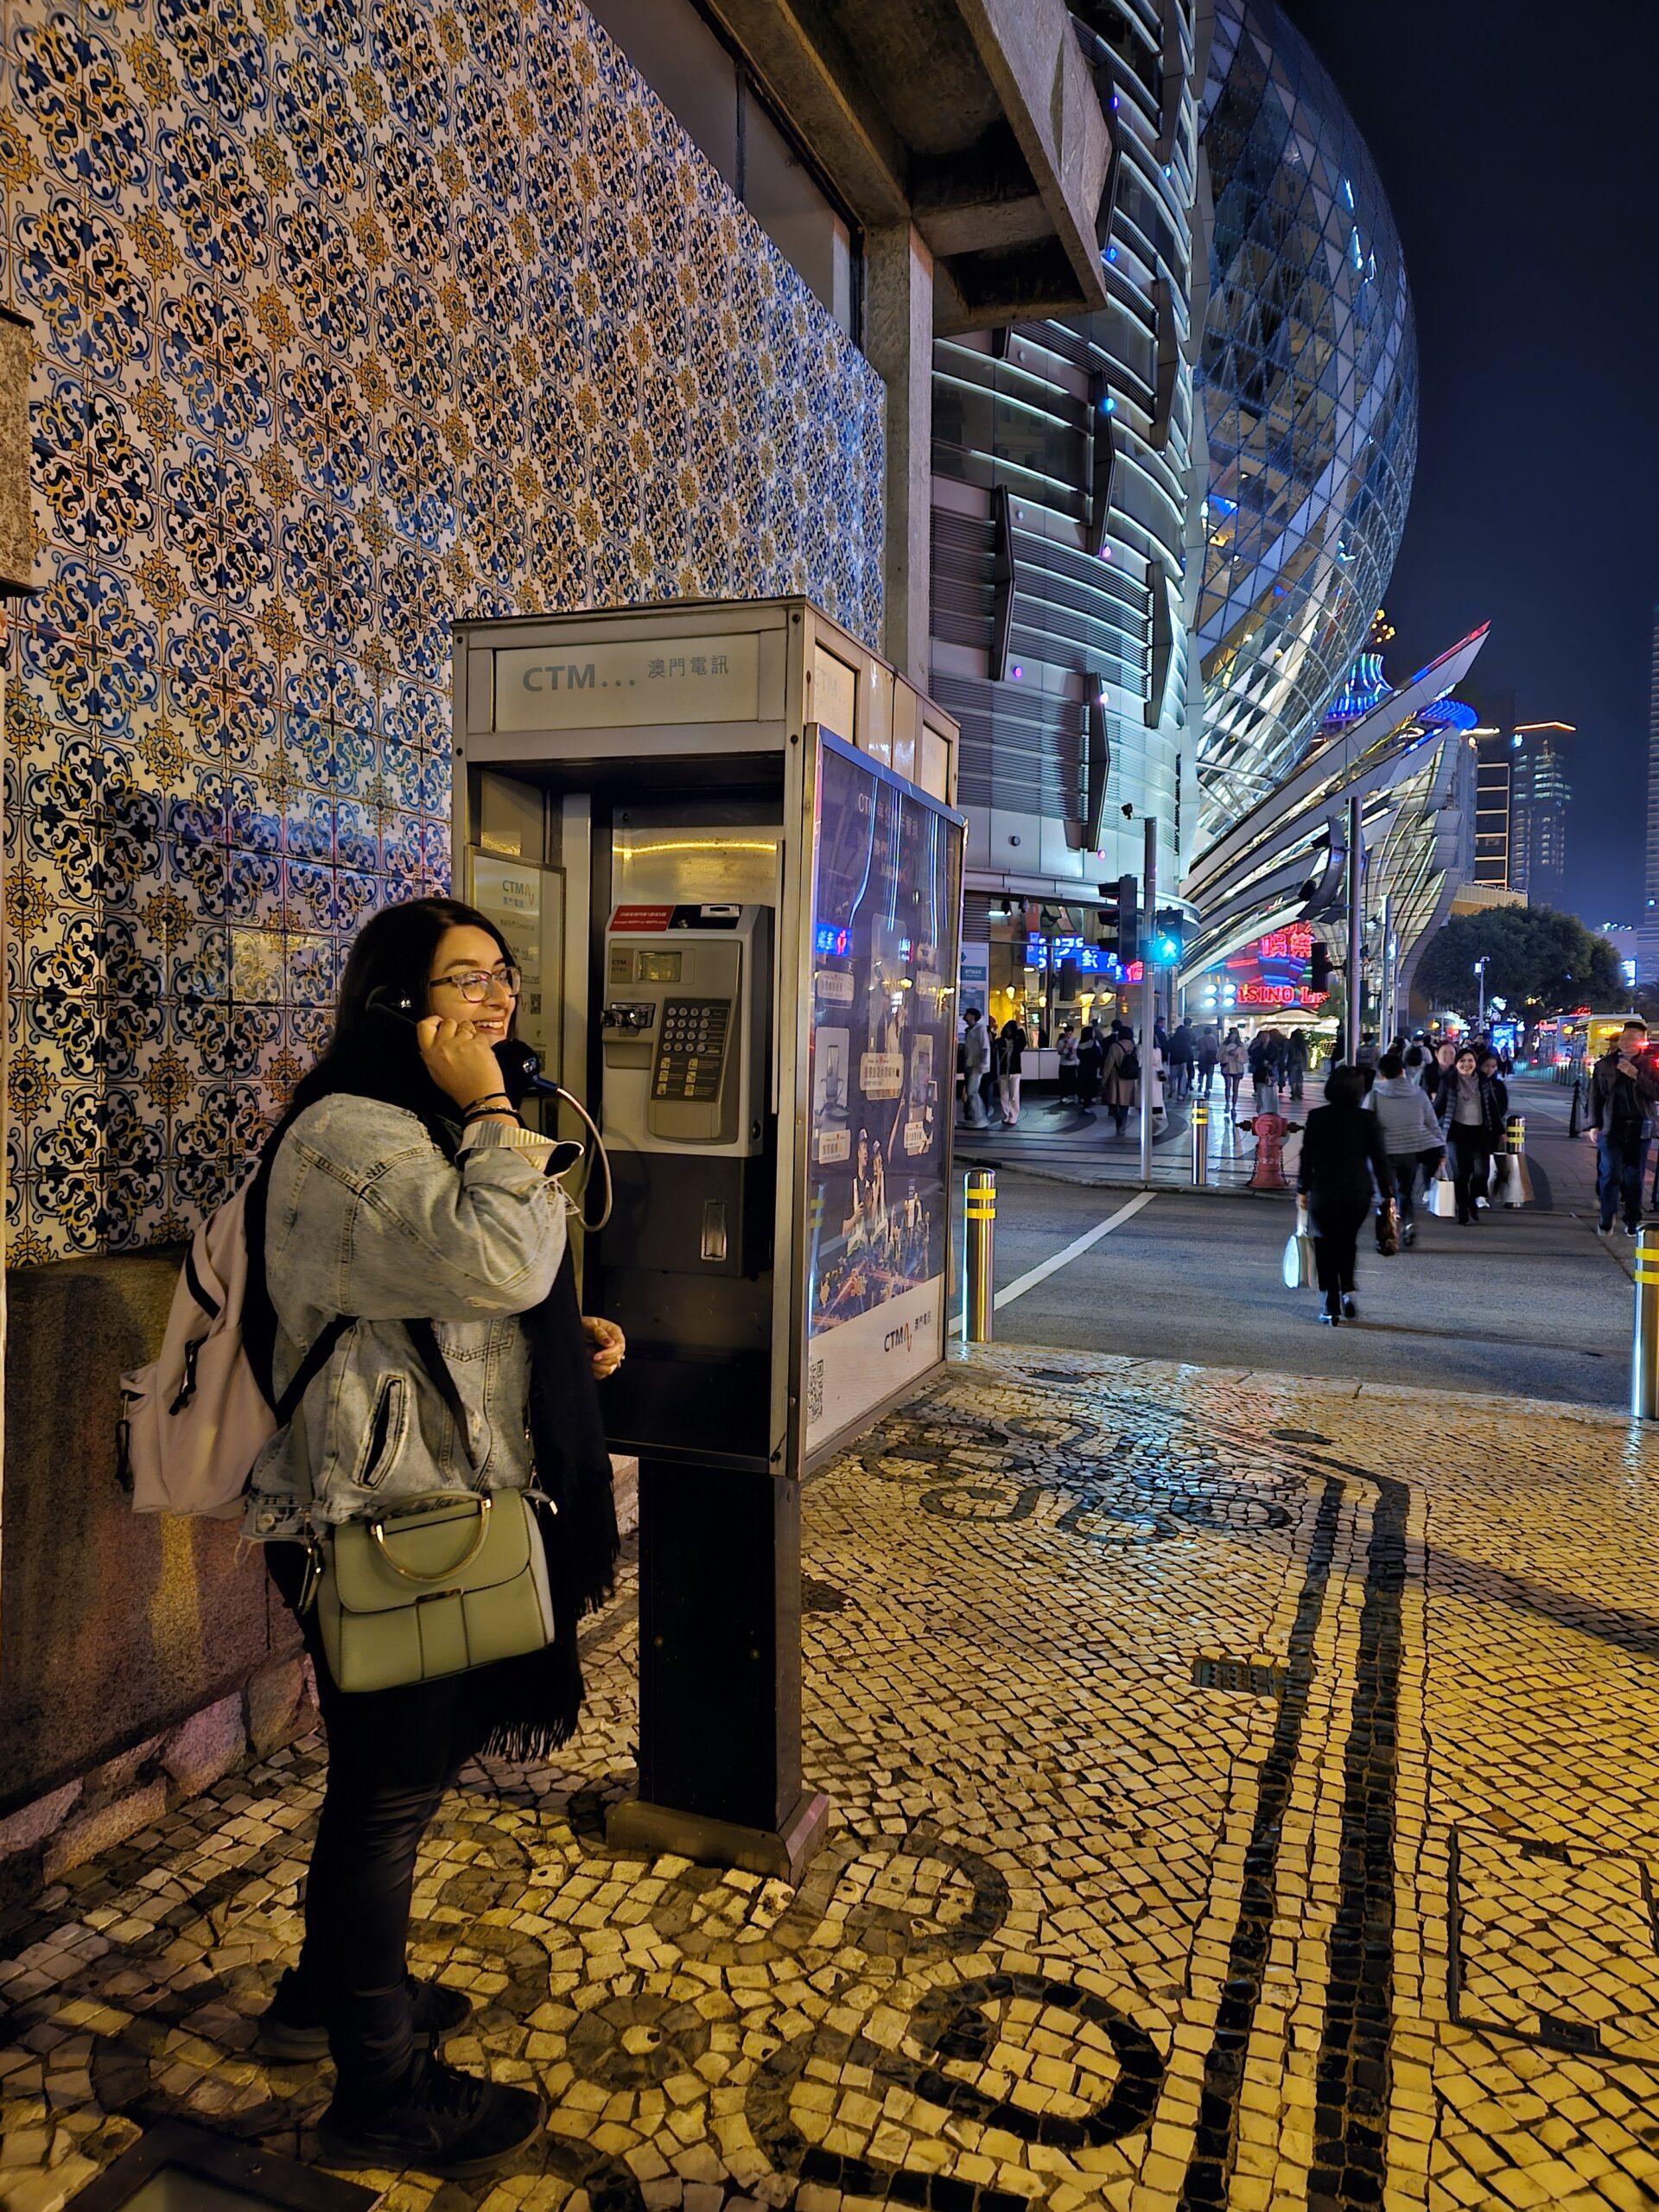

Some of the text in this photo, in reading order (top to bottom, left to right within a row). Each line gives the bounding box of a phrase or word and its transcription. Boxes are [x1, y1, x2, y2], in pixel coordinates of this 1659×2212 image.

[648, 655, 728, 678] 澳門電訊
[502, 880, 524, 895] CTM
[884, 1325, 904, 1353] CTM
